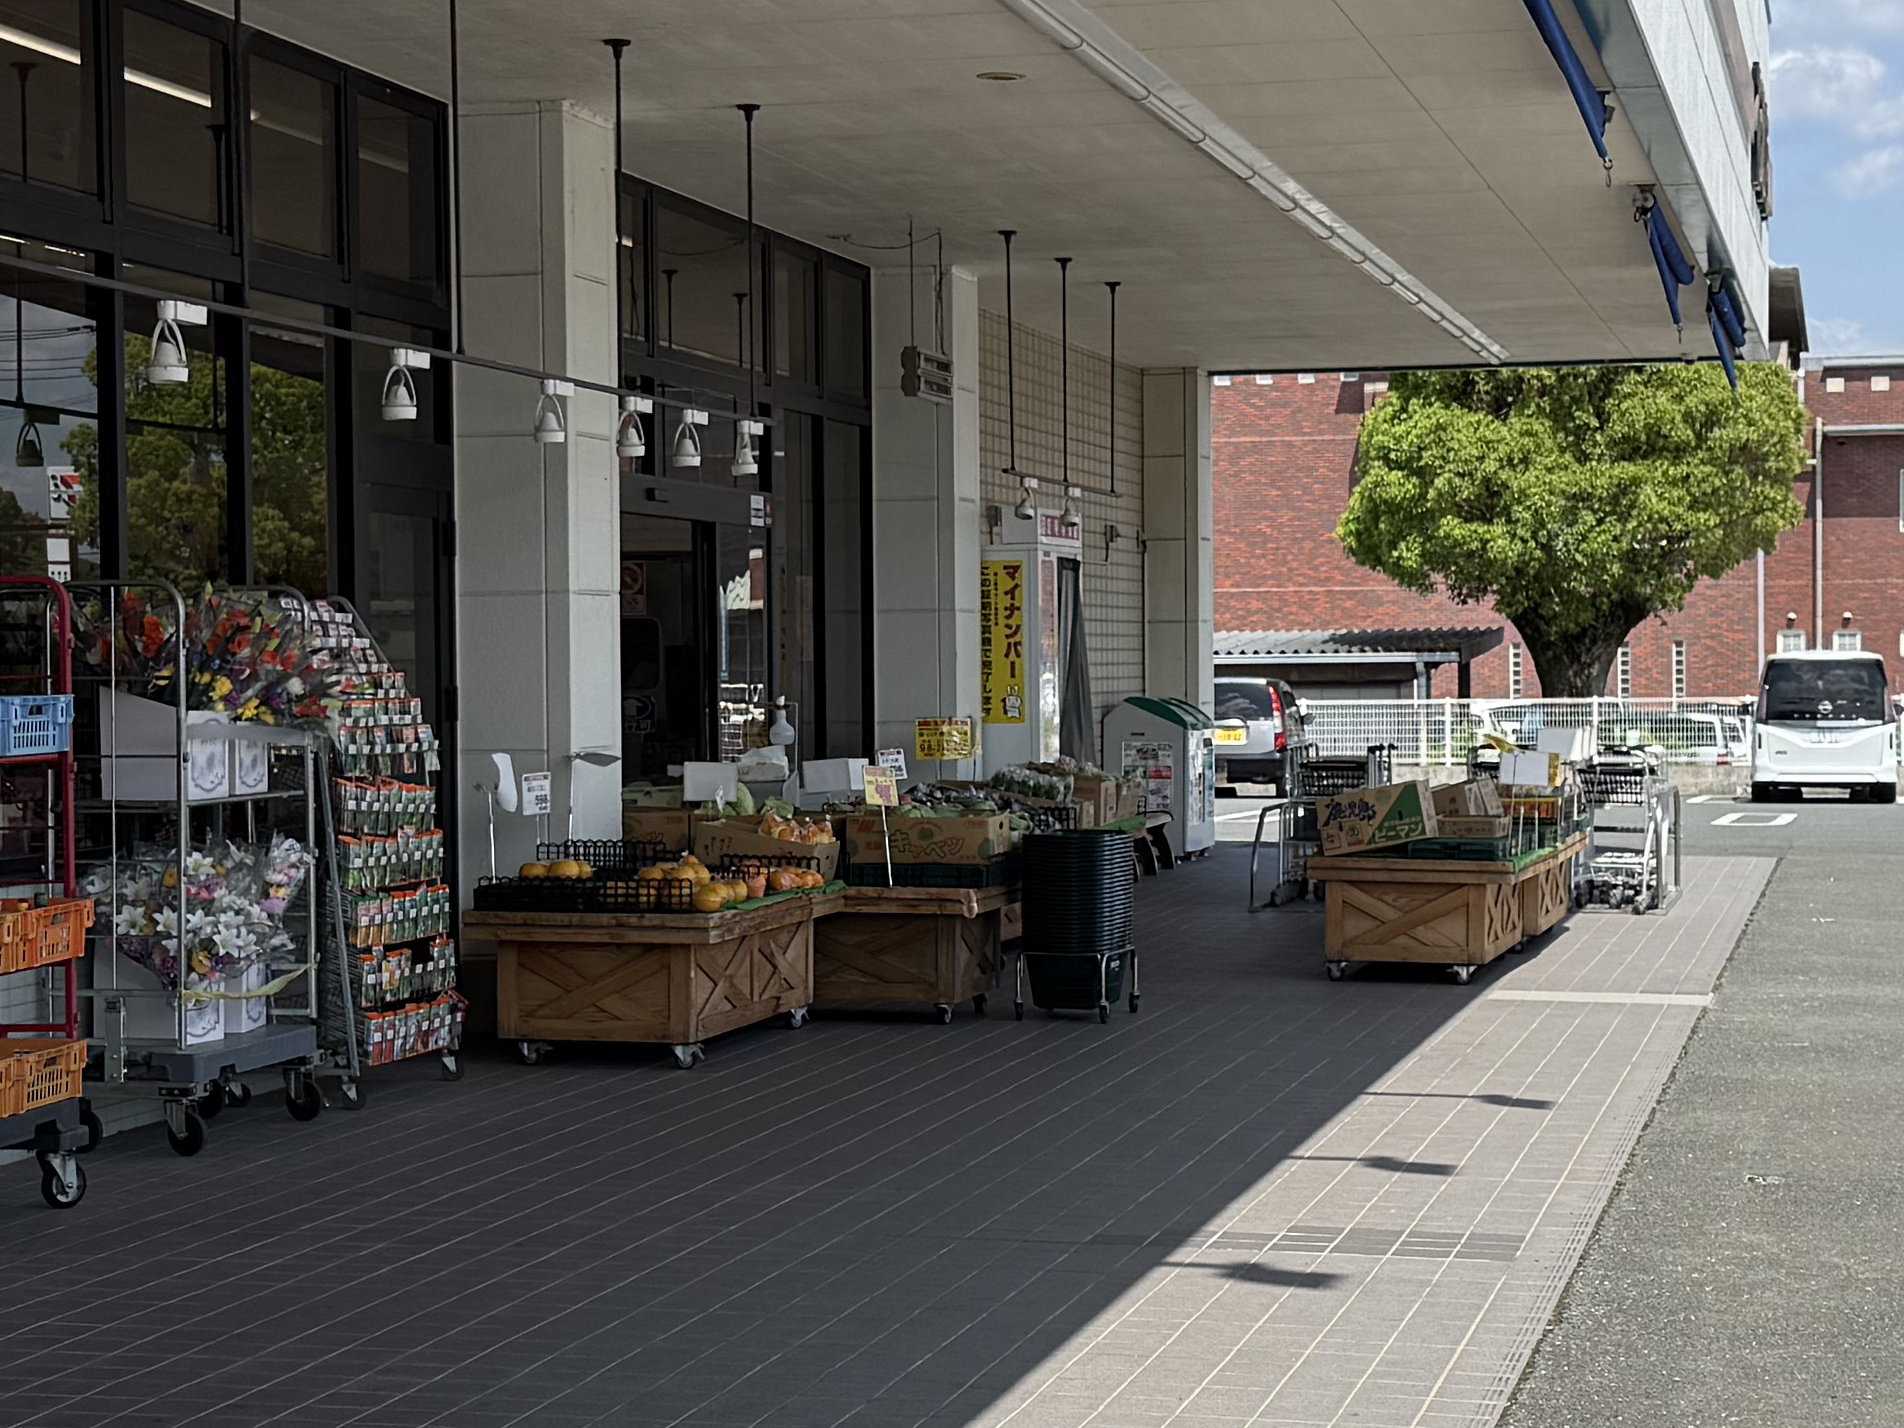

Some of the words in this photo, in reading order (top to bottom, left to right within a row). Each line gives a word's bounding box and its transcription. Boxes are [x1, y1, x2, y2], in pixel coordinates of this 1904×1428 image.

[1003, 564, 1023, 679] マイナンバー
[889, 828, 965, 859] キャベツ
[1375, 822, 1423, 843] ピーマン
